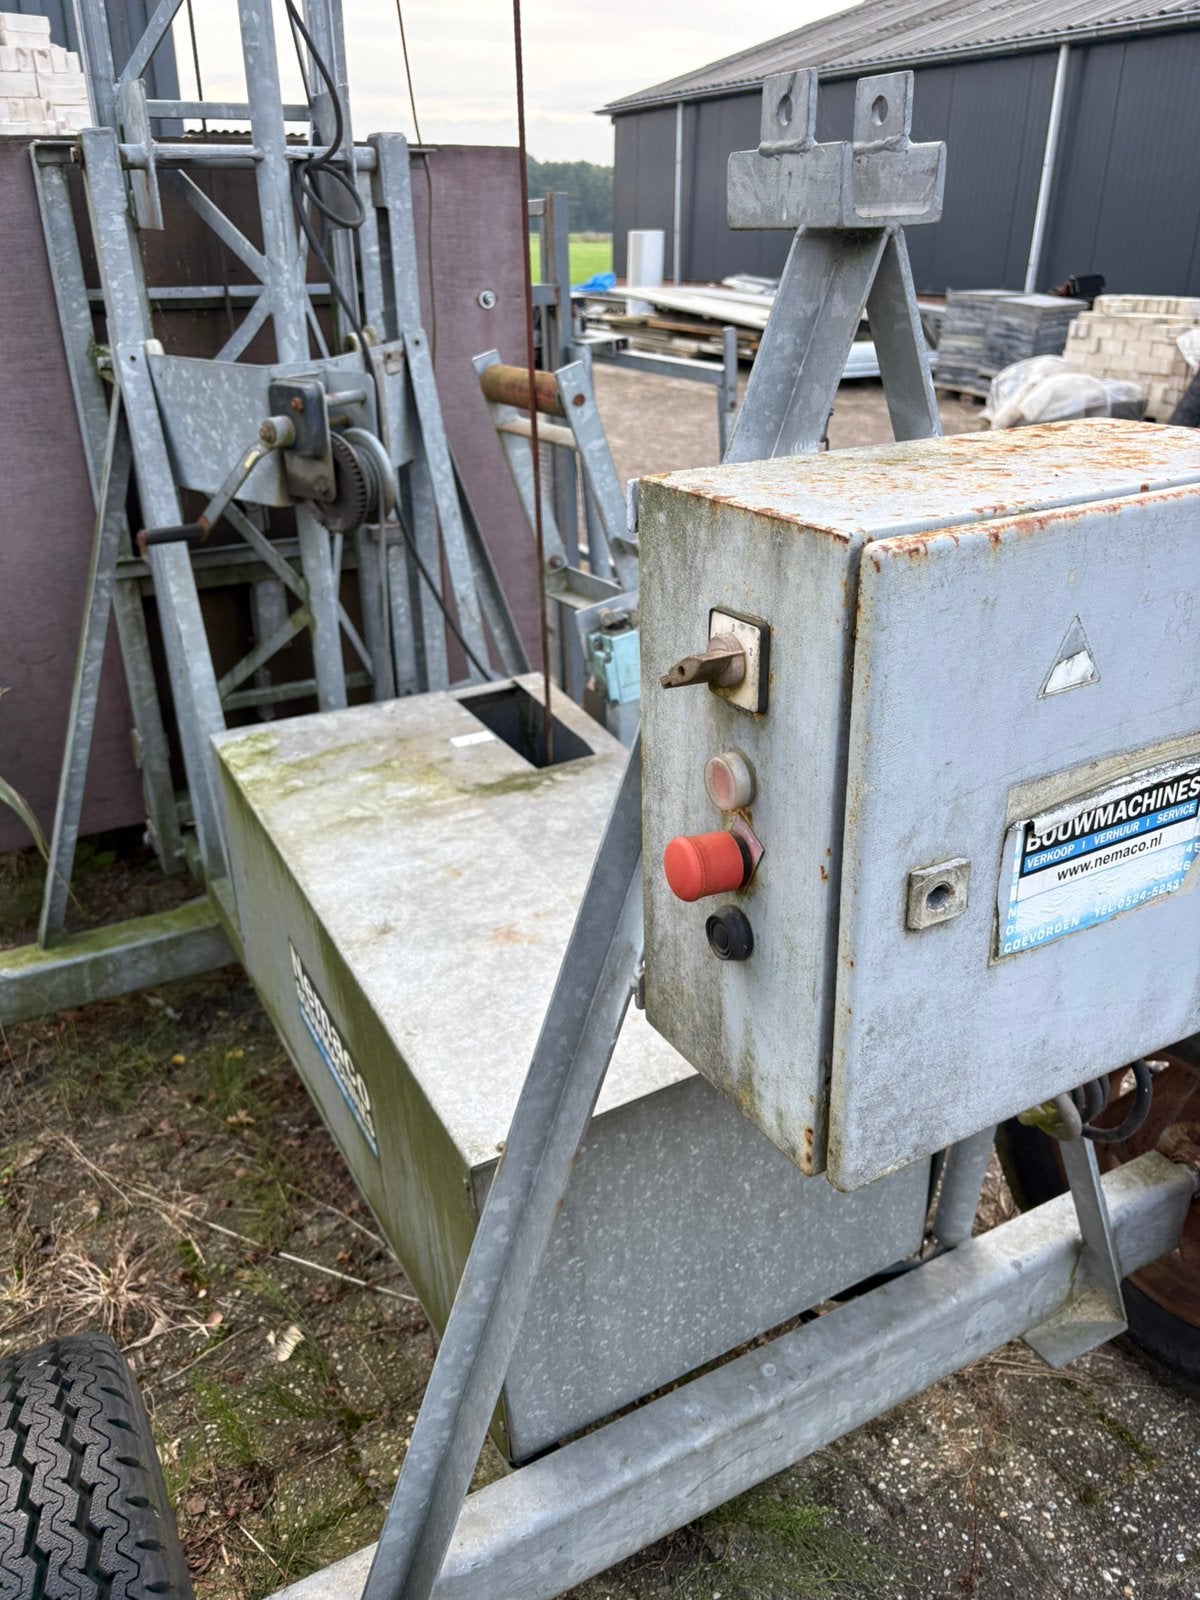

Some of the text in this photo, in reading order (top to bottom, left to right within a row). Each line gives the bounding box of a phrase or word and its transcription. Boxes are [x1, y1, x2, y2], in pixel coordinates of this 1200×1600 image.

[1026, 777, 1200, 852] BOUWMACHINES
[1027, 845, 1075, 869] VERKOOP
[1094, 822, 1139, 846] VERHUUR
[1156, 802, 1197, 824] SERVICE
[1057, 832, 1163, 882] www.nemaco.nl
